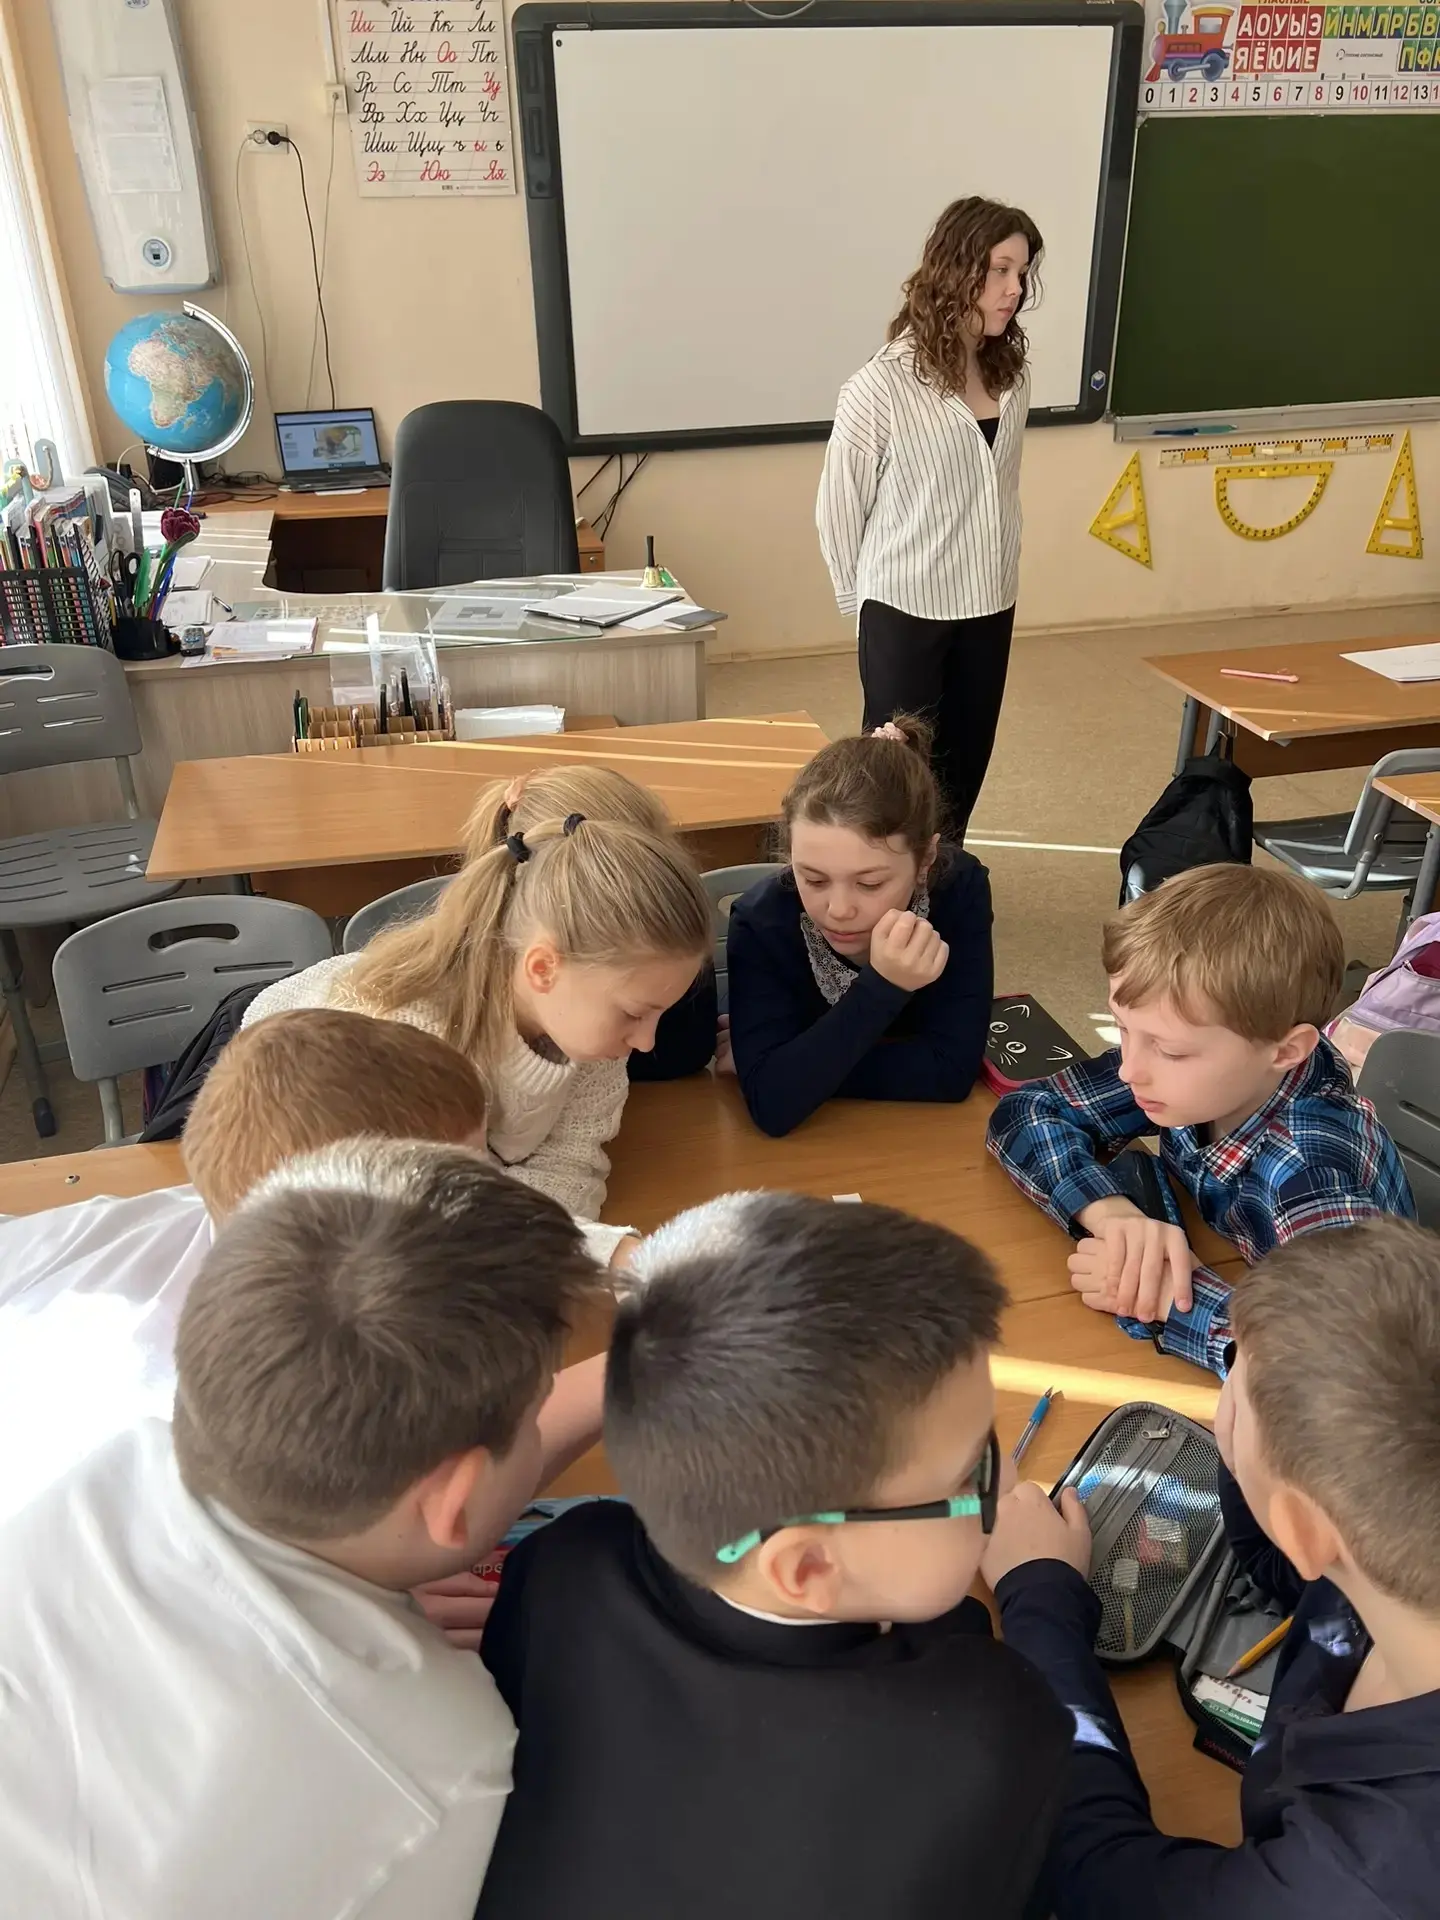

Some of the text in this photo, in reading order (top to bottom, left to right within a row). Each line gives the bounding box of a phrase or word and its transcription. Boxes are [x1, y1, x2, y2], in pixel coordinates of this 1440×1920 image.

[351, 7, 496, 33] Ии Йй Кк Лл
[351, 40, 497, 63] Мм Нн Оо Пп
[354, 71, 501, 102] Рр Сс Тт Уу
[1145, 88, 1154, 103] 0
[1169, 88, 1176, 103] 1
[1189, 88, 1198, 103] 2
[1210, 87, 1219, 102] 3
[1231, 86, 1240, 101] 4
[1252, 86, 1261, 101] 5
[1273, 86, 1282, 101] 6
[1295, 86, 1303, 101] 7
[1315, 86, 1323, 100] 8
[1335, 85, 1344, 100] 9
[1352, 85, 1368, 100] 10
[1374, 85, 1388, 100] 11
[1393, 85, 1408, 100] 12
[1413, 85, 1429, 99] 13
[359, 101, 500, 131] Фф Хх Цц Чч
[364, 132, 398, 152] Шш
[407, 131, 445, 157] Щщ
[366, 160, 507, 182] Ээ Юю Яя
